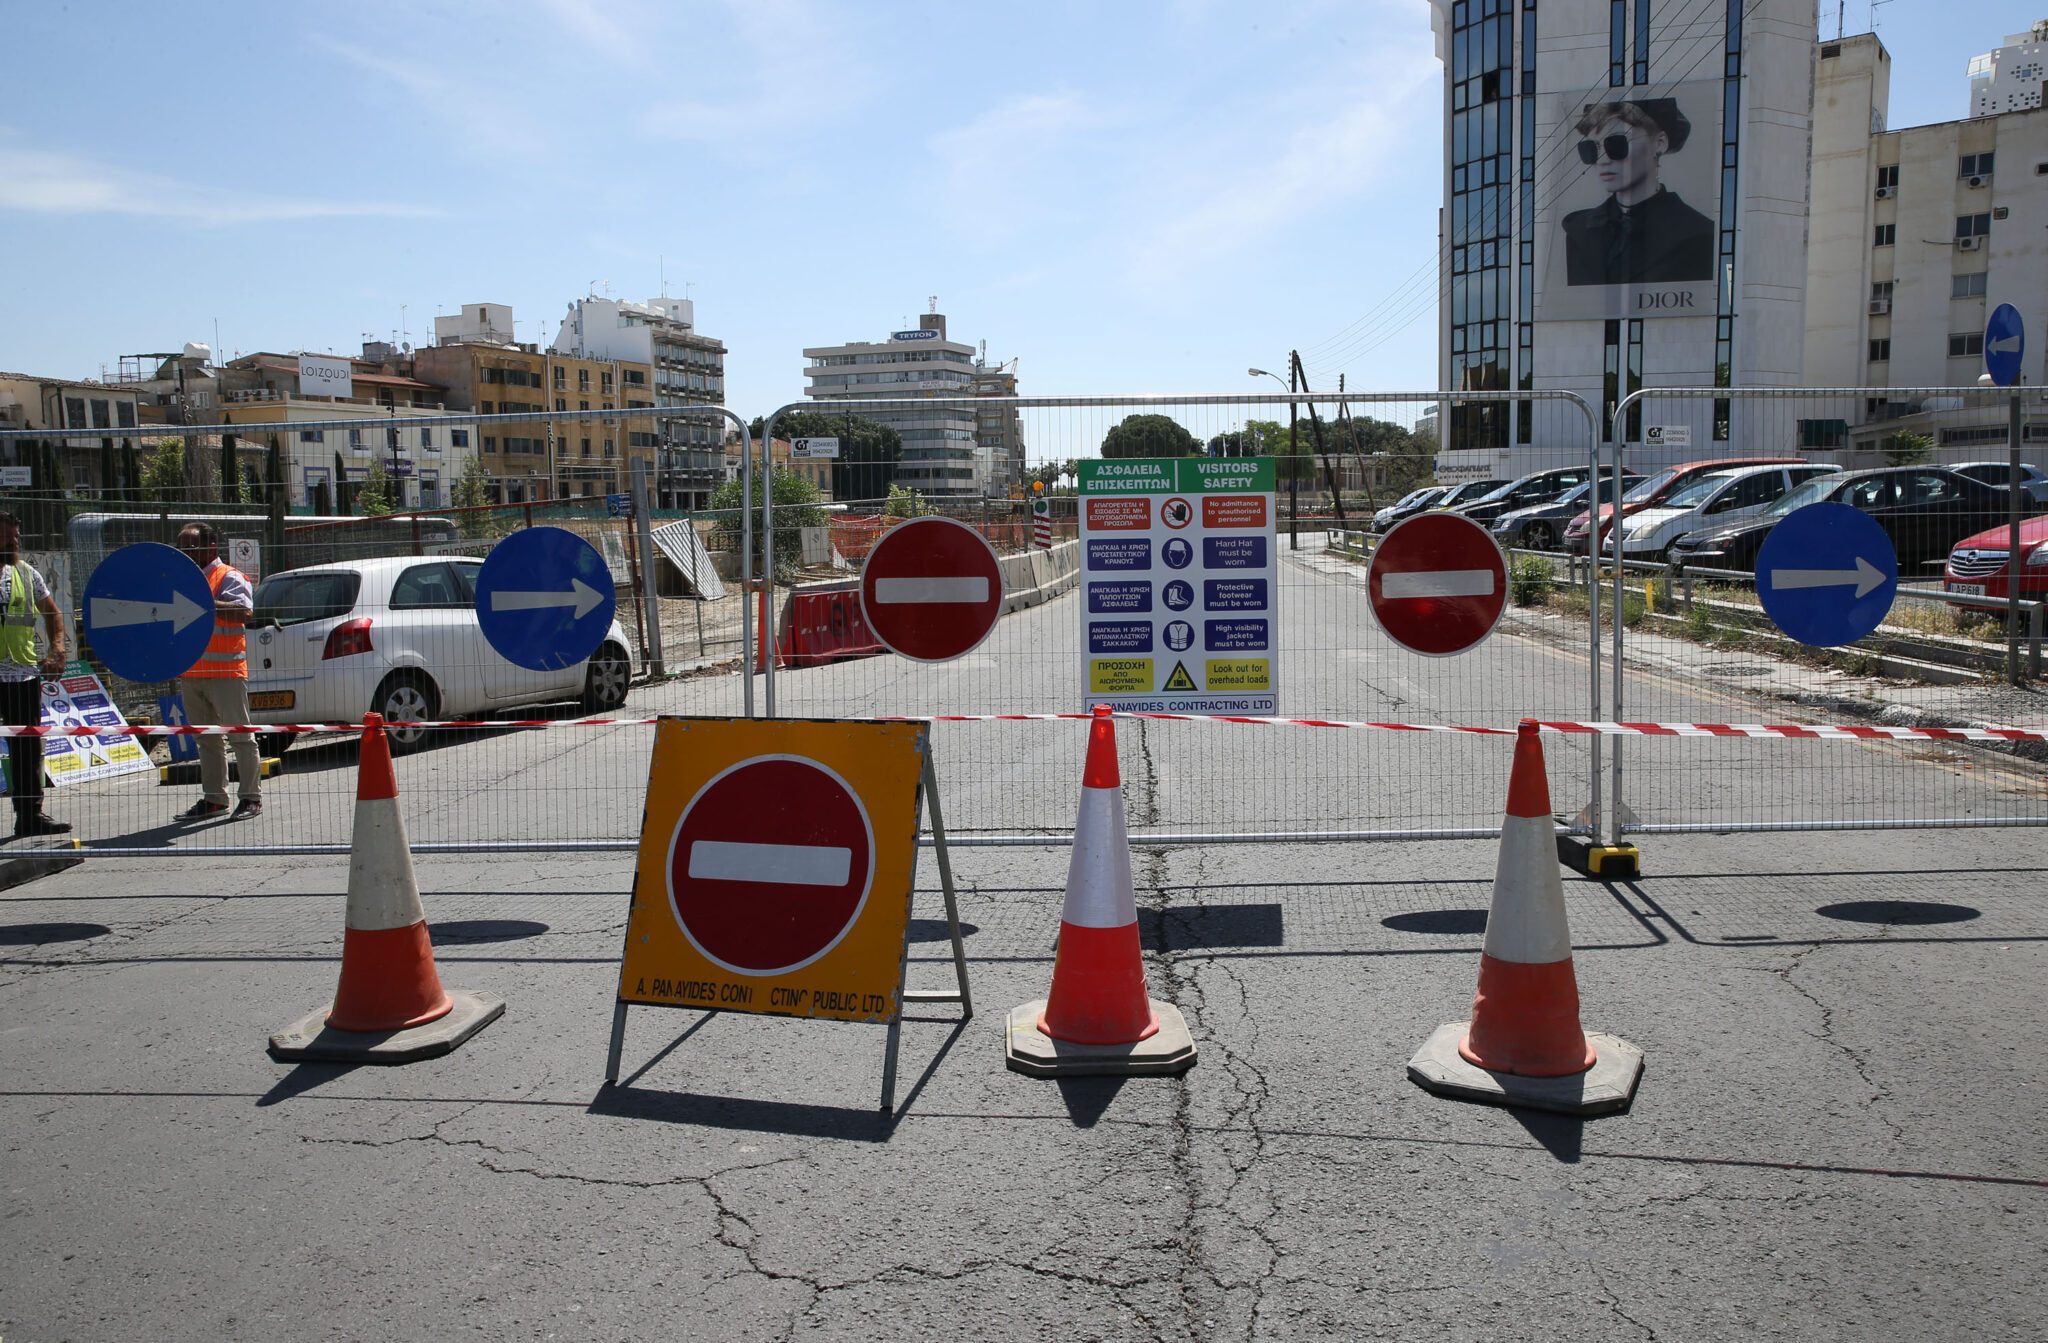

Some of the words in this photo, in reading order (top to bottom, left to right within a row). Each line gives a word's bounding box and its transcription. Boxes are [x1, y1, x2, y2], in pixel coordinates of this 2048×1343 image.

[1639, 291, 1695, 309] DIOR
[301, 366, 349, 379] LOIZOUDI
[1096, 465, 1161, 475] ΑΣΦΑΛΕΙΑ
[1198, 463, 1258, 473] VISITORS
[1087, 479, 1170, 490] ΕΠΙΣΚΕΠΤΩΝ
[1204, 478, 1253, 488] SAFETY
[1235, 624, 1264, 632] visibility
[1098, 662, 1145, 670] ΠΡΟΣΟΧΗ
[1214, 664, 1232, 672] Look
[1236, 664, 1248, 672] out
[1252, 664, 1263, 672] for
[1209, 676, 1244, 684] overhead
[1247, 675, 1268, 684] loads
[1104, 702, 1164, 712] ANAYIDES
[1169, 700, 1249, 711] CONTRACTING
[1253, 700, 1272, 710] LTD
[636, 978, 647, 996] A.
[813, 991, 857, 1012] PUBLIC
[861, 994, 885, 1014] LTD
